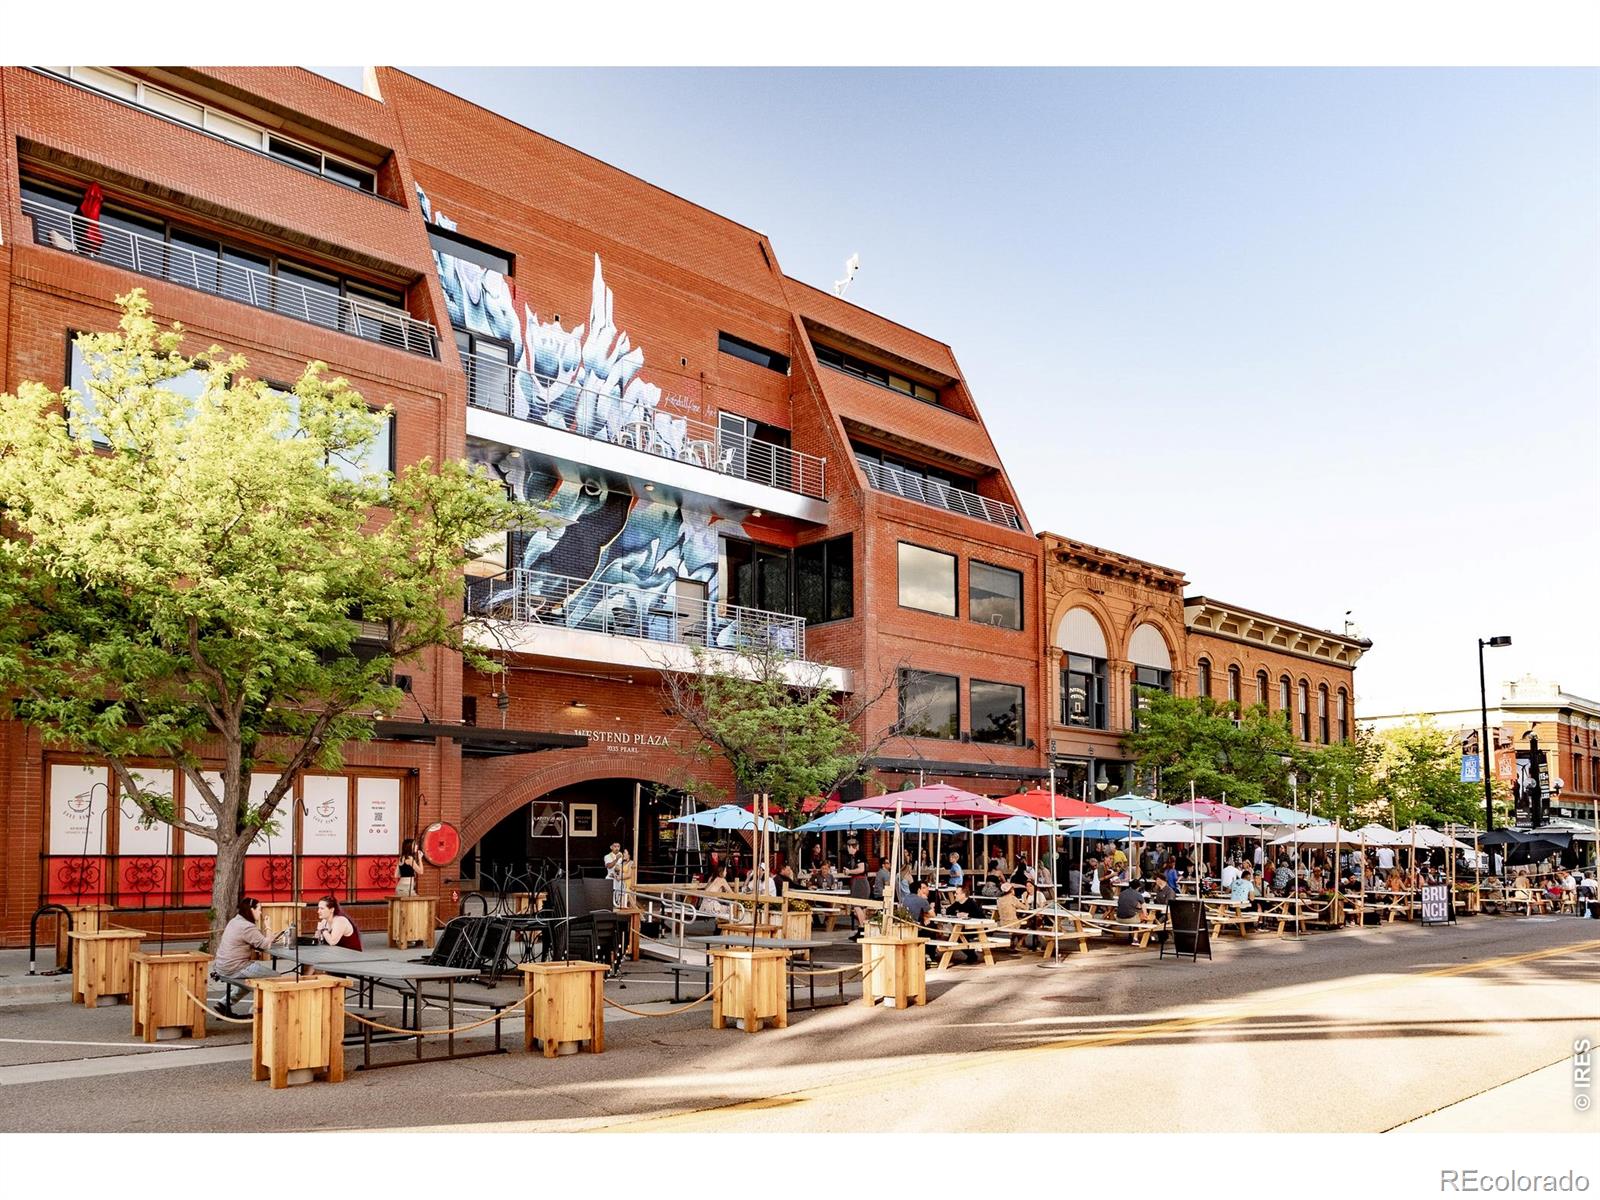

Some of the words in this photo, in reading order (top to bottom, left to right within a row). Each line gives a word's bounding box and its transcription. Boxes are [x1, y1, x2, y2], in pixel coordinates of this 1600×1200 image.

[634, 733, 670, 746] PLAZA
[1421, 885, 1448, 901] BRU
[1421, 902, 1448, 917] NCH
